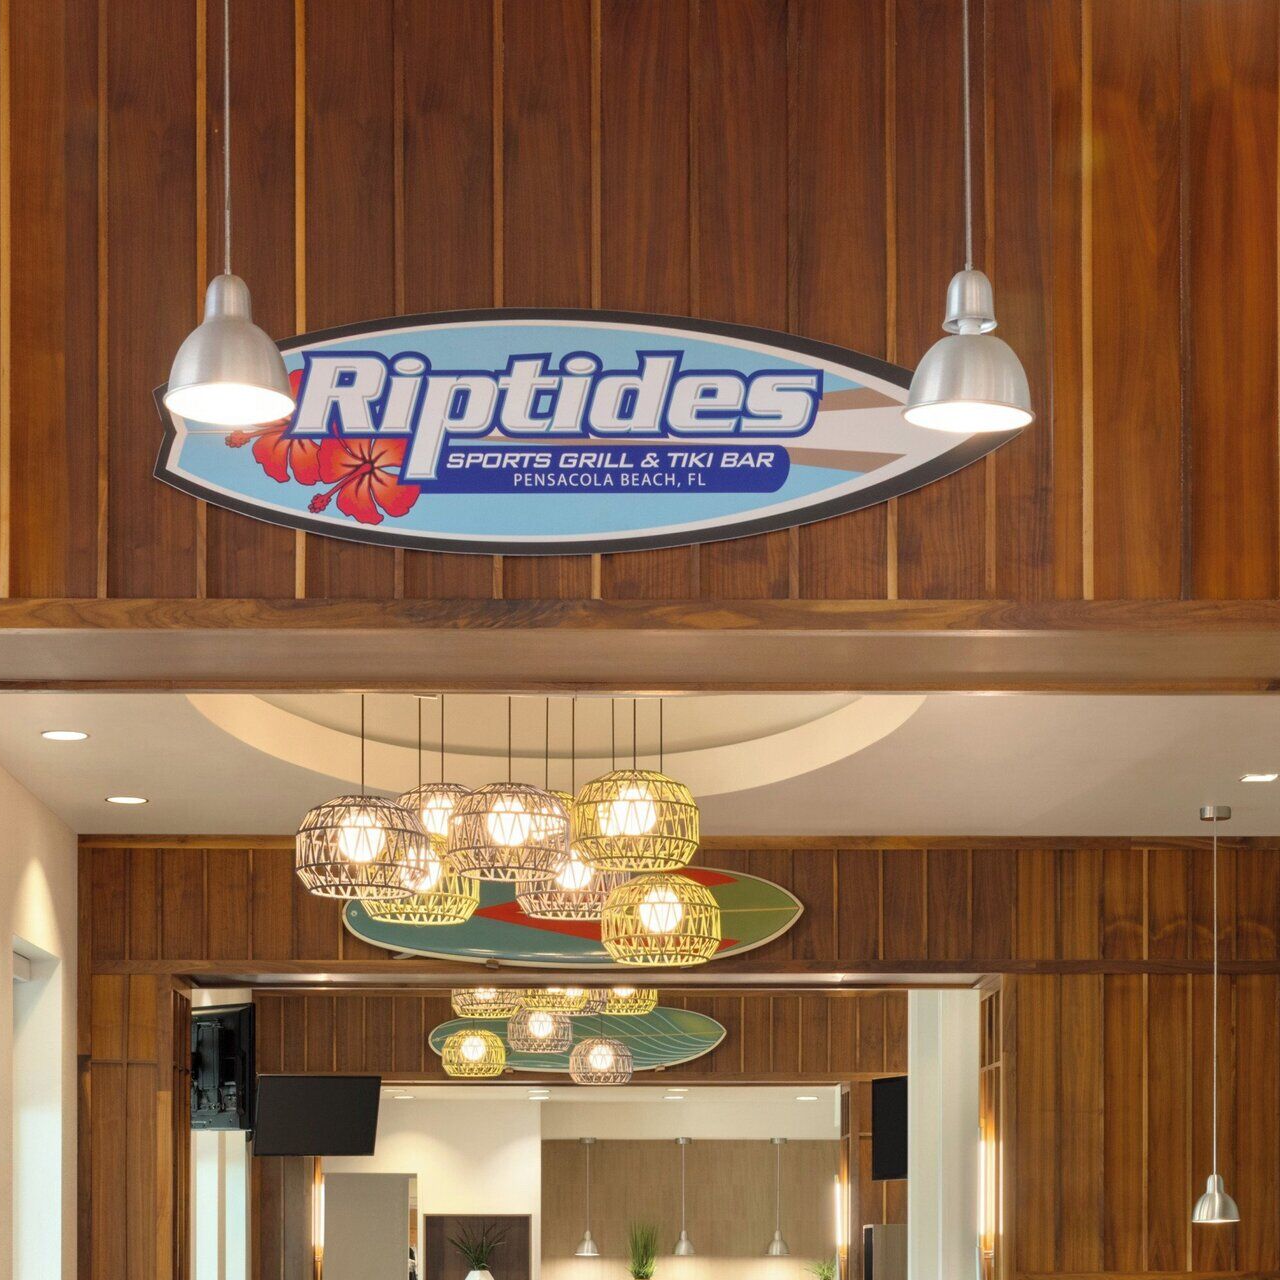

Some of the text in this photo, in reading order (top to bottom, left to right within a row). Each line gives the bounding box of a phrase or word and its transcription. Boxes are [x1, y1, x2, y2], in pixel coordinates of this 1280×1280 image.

[294, 350, 821, 484] Riptides
[446, 452, 774, 469] SPORTS GRILL & TIKI BAR
[513, 472, 707, 489] PENSACOLA BEACH, FL
